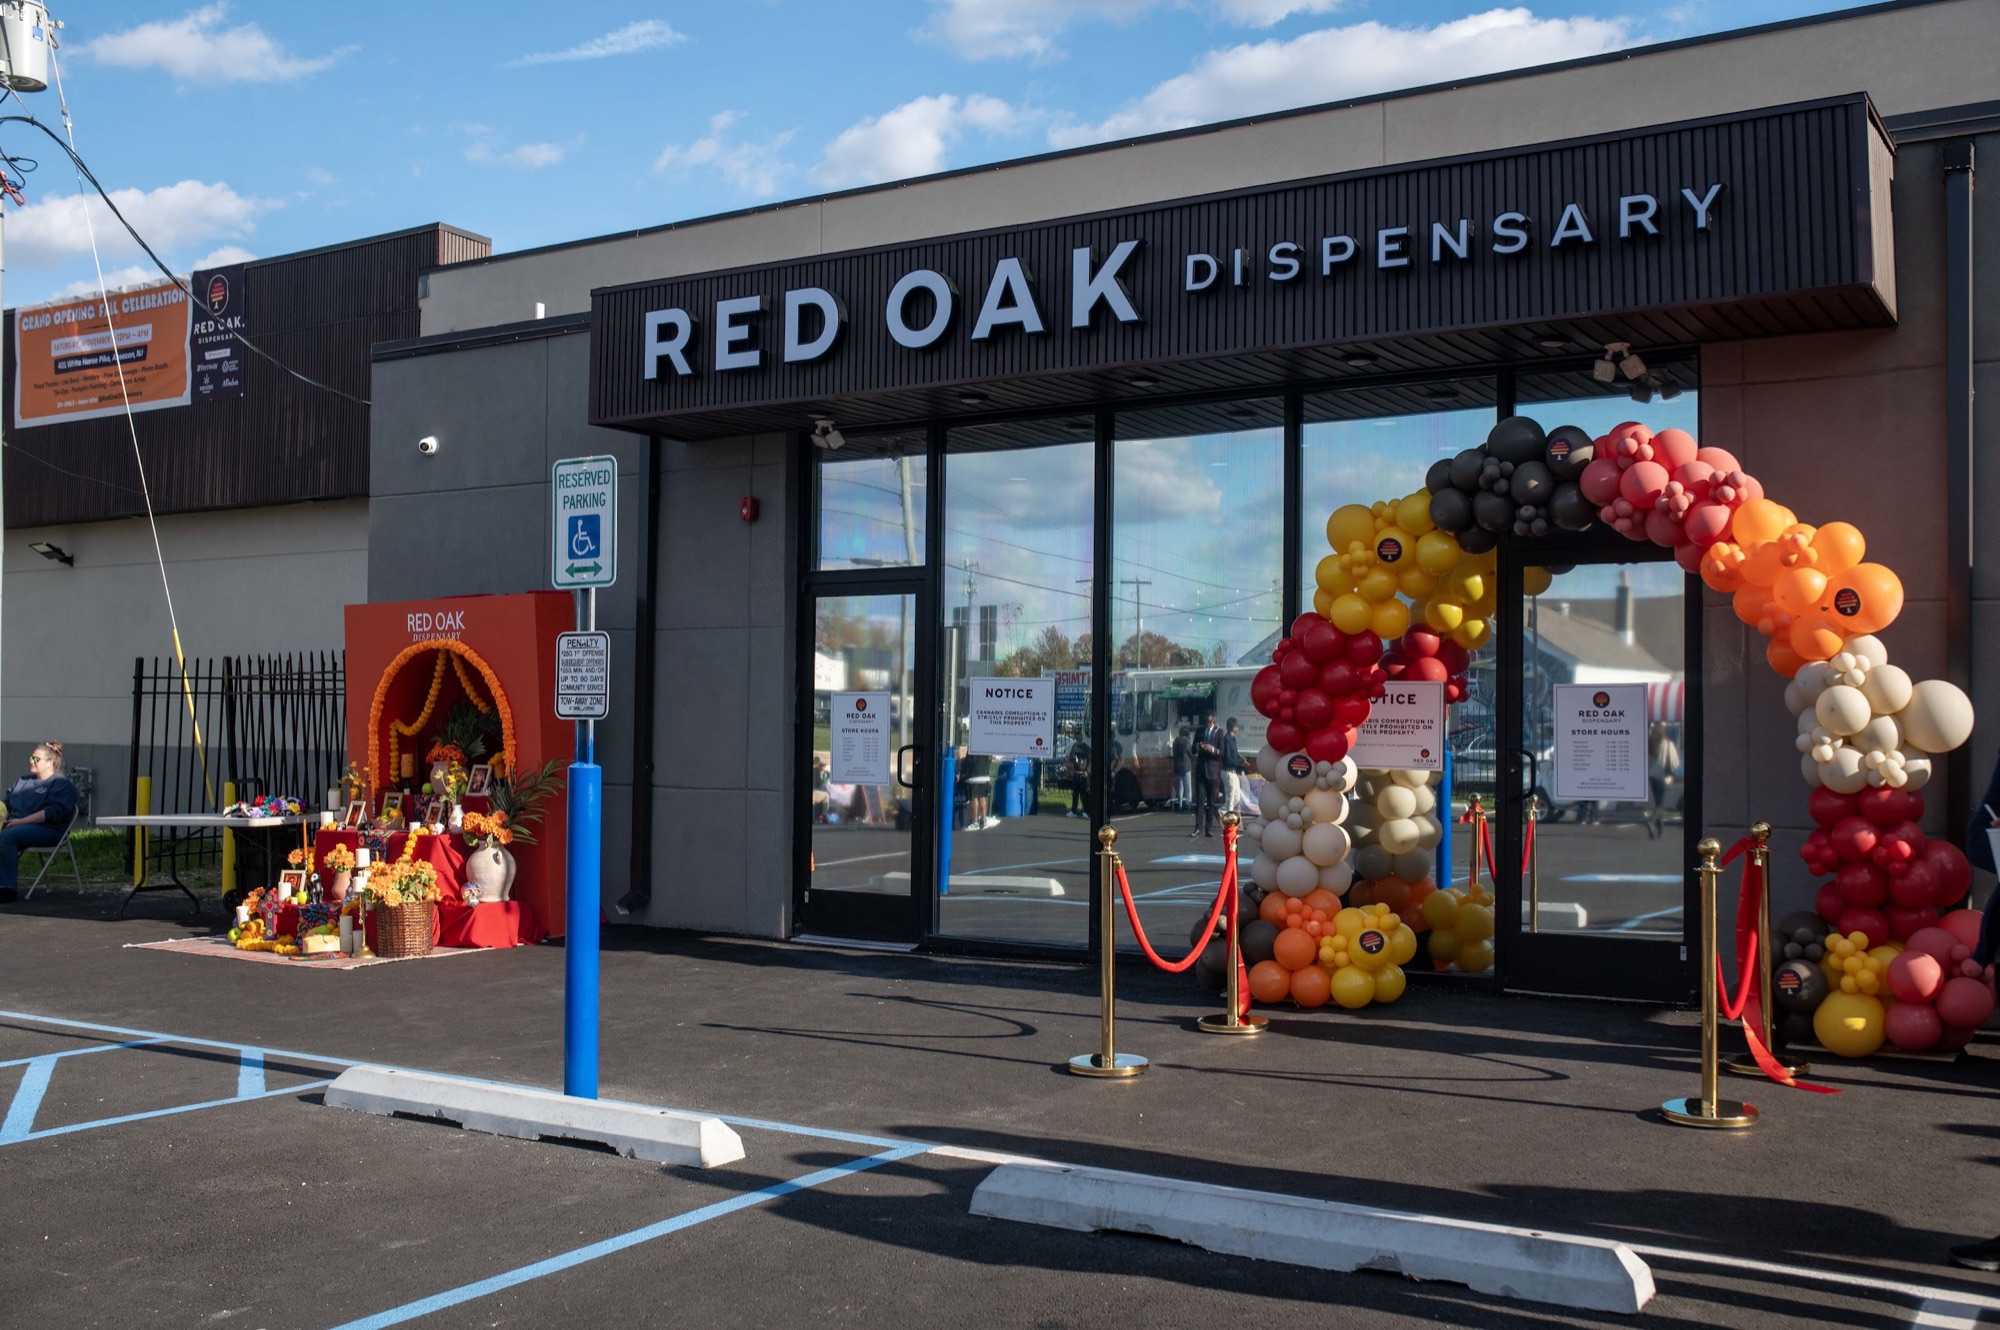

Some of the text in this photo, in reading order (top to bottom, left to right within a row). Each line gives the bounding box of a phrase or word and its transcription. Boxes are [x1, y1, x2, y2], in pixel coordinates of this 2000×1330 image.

[644, 182, 1724, 381] RED OAK DISPENSARY
[22, 288, 186, 332] GRAND OPENING FALL CELEBRATION
[194, 320, 214, 335] RED
[82, 336, 110, 347] NOVEMBER
[137, 329, 148, 338] 4PM
[198, 334, 236, 344] DISPENSAR
[67, 358, 81, 368] White
[82, 356, 98, 366] Horse
[112, 352, 136, 362] Asecon,
[136, 349, 144, 358] NJ
[558, 470, 610, 489] RESERVED
[563, 492, 606, 510] PARKING
[408, 610, 465, 632] RED OAK
[412, 632, 460, 642] DISPENSARY
[567, 639, 599, 648] PENALTY
[560, 697, 603, 705] TOW-AWAY ZONE
[986, 688, 1033, 699] NOTICE
[1370, 694, 1416, 704] OTICE
